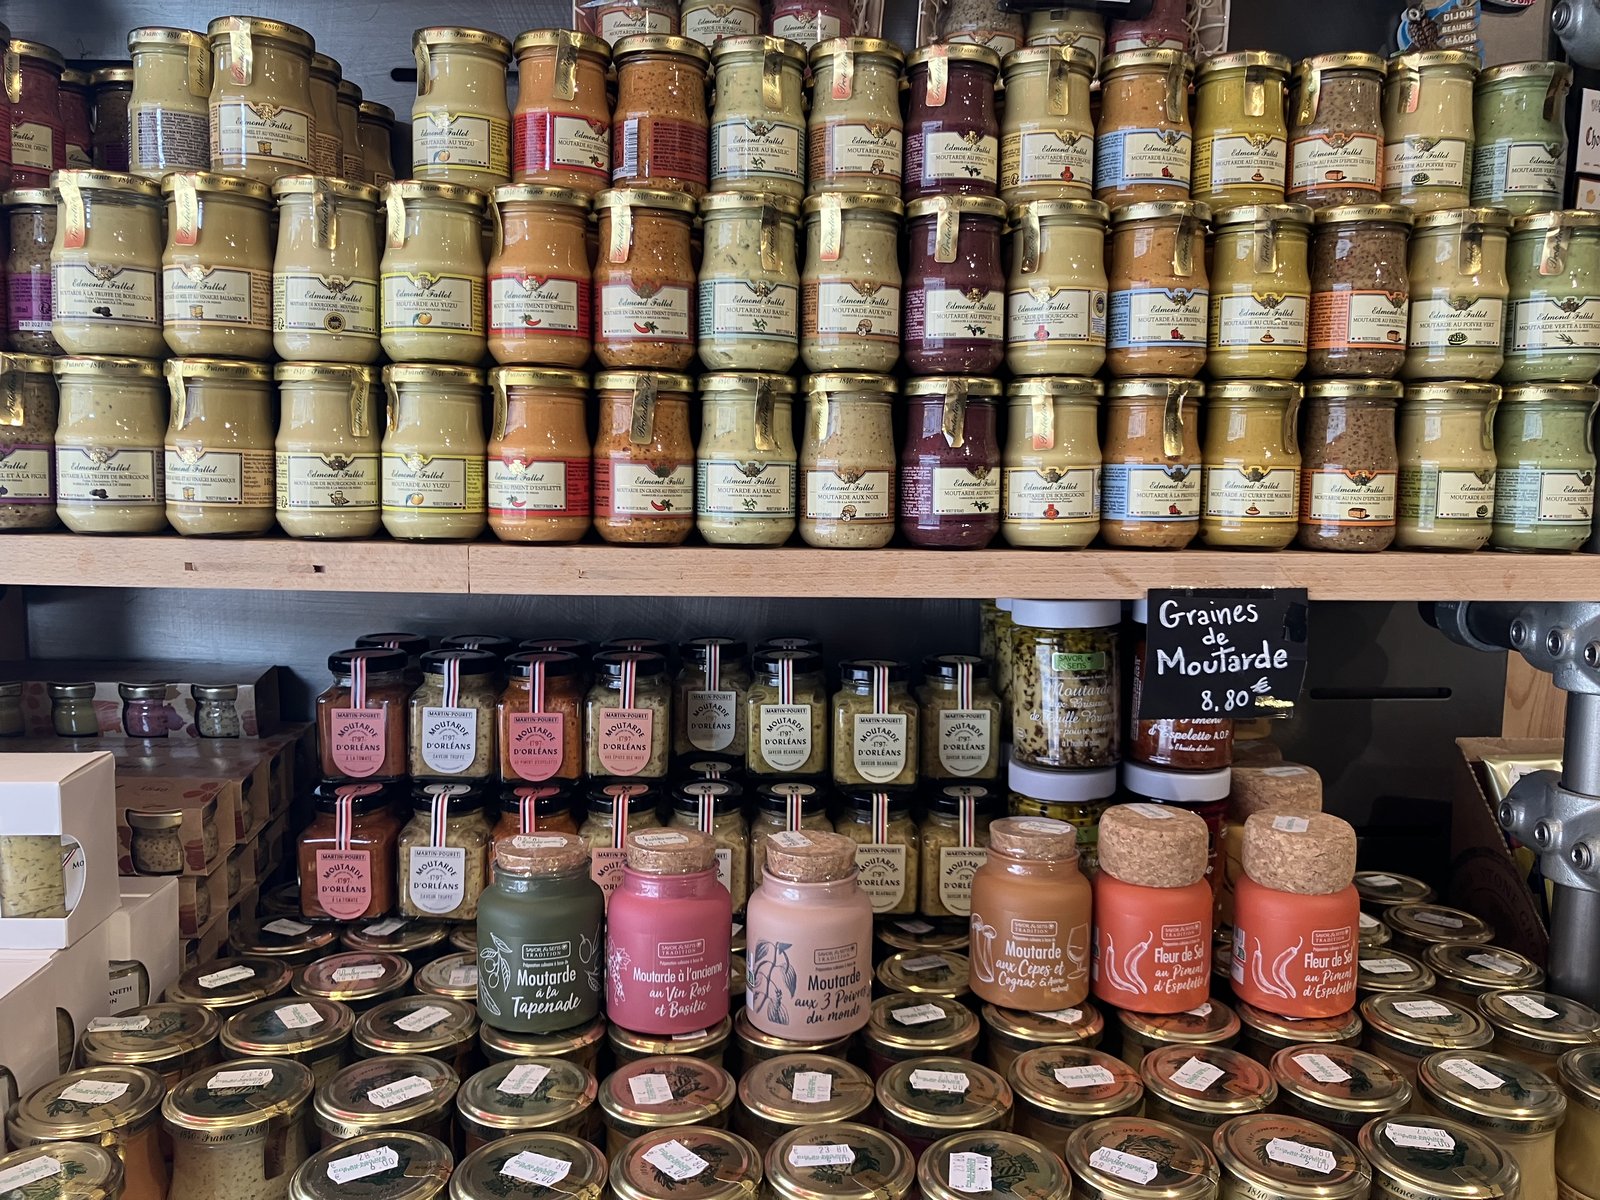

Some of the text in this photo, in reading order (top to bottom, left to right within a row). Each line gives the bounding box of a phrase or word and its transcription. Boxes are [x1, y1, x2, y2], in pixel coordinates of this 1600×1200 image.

[1443, 10, 1474, 21] DIJON
[1441, 22, 1472, 34] BEAUNE
[733, 136, 784, 146] Edmond Fallot
[944, 144, 972, 154] Edmond
[1308, 148, 1362, 158] Edmond Fallot
[1394, 151, 1450, 161] Edmond Fallot
[72, 279, 135, 291] Edmond Fallot
[504, 291, 559, 300] Edmond Fallot
[1429, 310, 1487, 320] Edmond Fallot
[70, 462, 131, 472] Edmond Fallot
[722, 476, 776, 485] Edmond Fallot
[821, 483, 875, 492] Edmond Fallot
[1023, 481, 1077, 491] Edmond Fallot
[1224, 481, 1280, 490] Edmond Fallot
[1159, 600, 1258, 628] Graines
[1202, 627, 1229, 645] de
[1157, 640, 1288, 676] Moutarde
[693, 703, 729, 717] MOUTARDE
[1030, 710, 1040, 720] de
[338, 722, 378, 738] MOUTARDE
[429, 720, 470, 736] MOUTARDE
[605, 722, 645, 738] MOUTARDE
[766, 717, 805, 732] MOUTARDE
[945, 722, 984, 738] MOUTARDE
[1148, 723, 1211, 742] d'Espelette
[515, 726, 556, 742] MOUTARDE
[860, 727, 900, 743] MOUTARDE
[323, 863, 364, 880] MOUTARDE
[415, 860, 457, 876] MOUTARDE
[860, 857, 899, 873] MOUTARDE
[1005, 940, 1061, 959] Moutarde
[1155, 941, 1204, 963] Fleur de Sel
[1305, 946, 1352, 968] Fleur de Sel
[517, 965, 576, 986] Moutarde
[633, 962, 722, 983] Moutarde à l'ancienne
[996, 960, 1017, 973] aux
[1054, 961, 1065, 976] et
[1173, 961, 1203, 980] Piment
[1323, 967, 1352, 985] Piment
[808, 966, 861, 991] Moutarde
[999, 971, 1037, 992] Cognac
[536, 986, 559, 999] à la
[650, 989, 664, 998] au
[666, 986, 687, 1002] Vin
[512, 993, 581, 1019] Tapenade
[655, 1000, 706, 1018] et Basilic
[795, 999, 818, 1009] aux
[821, 992, 831, 1010] 3
[807, 1010, 824, 1024] du
[202, 1131, 235, 1142] France
